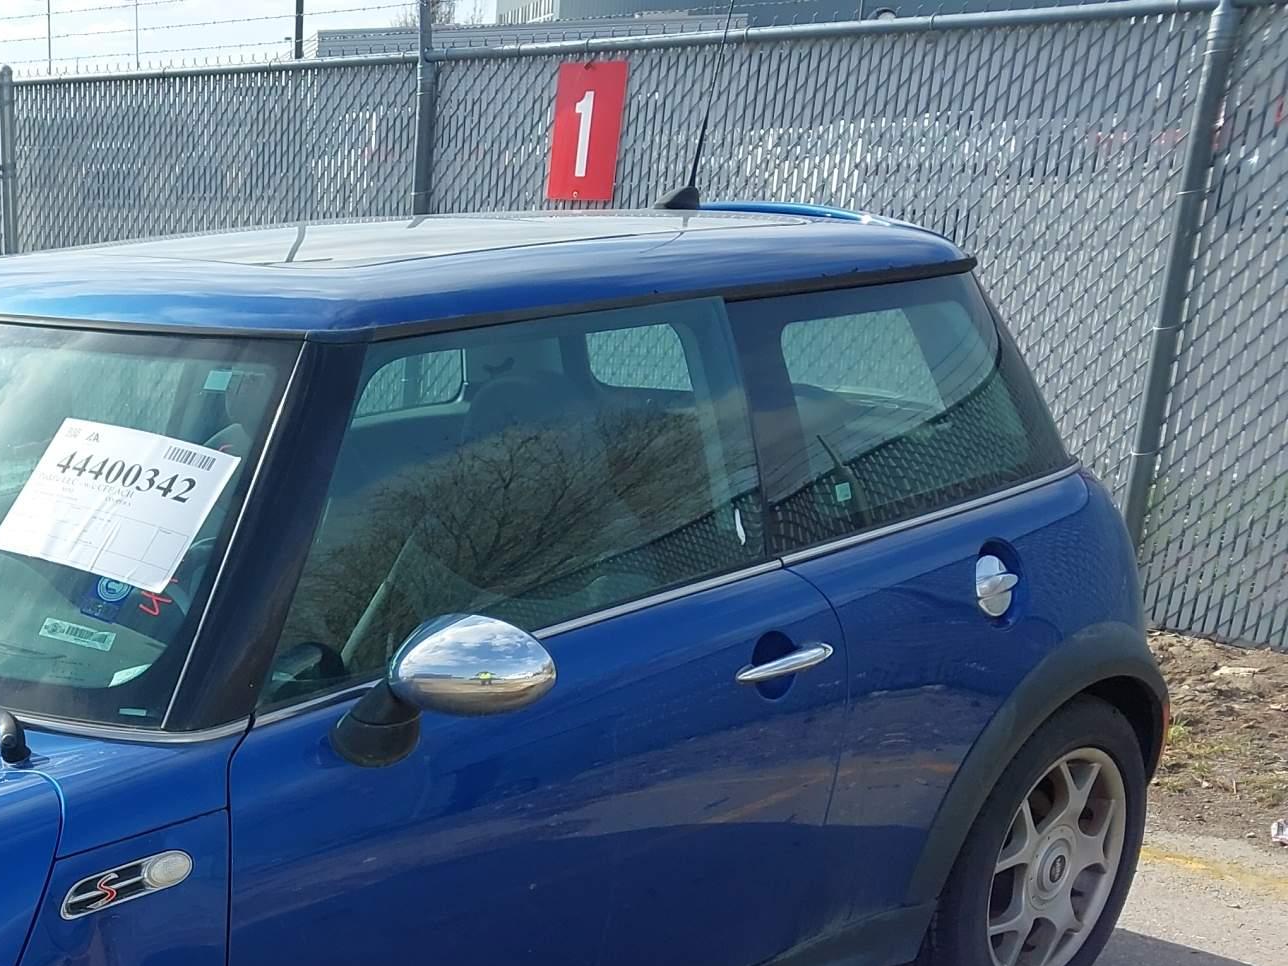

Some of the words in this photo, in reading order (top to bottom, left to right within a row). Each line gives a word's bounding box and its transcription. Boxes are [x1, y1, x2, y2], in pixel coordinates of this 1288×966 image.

[575, 91, 594, 177] 1
[56, 450, 197, 503] 44400342
[86, 872, 119, 909] S
